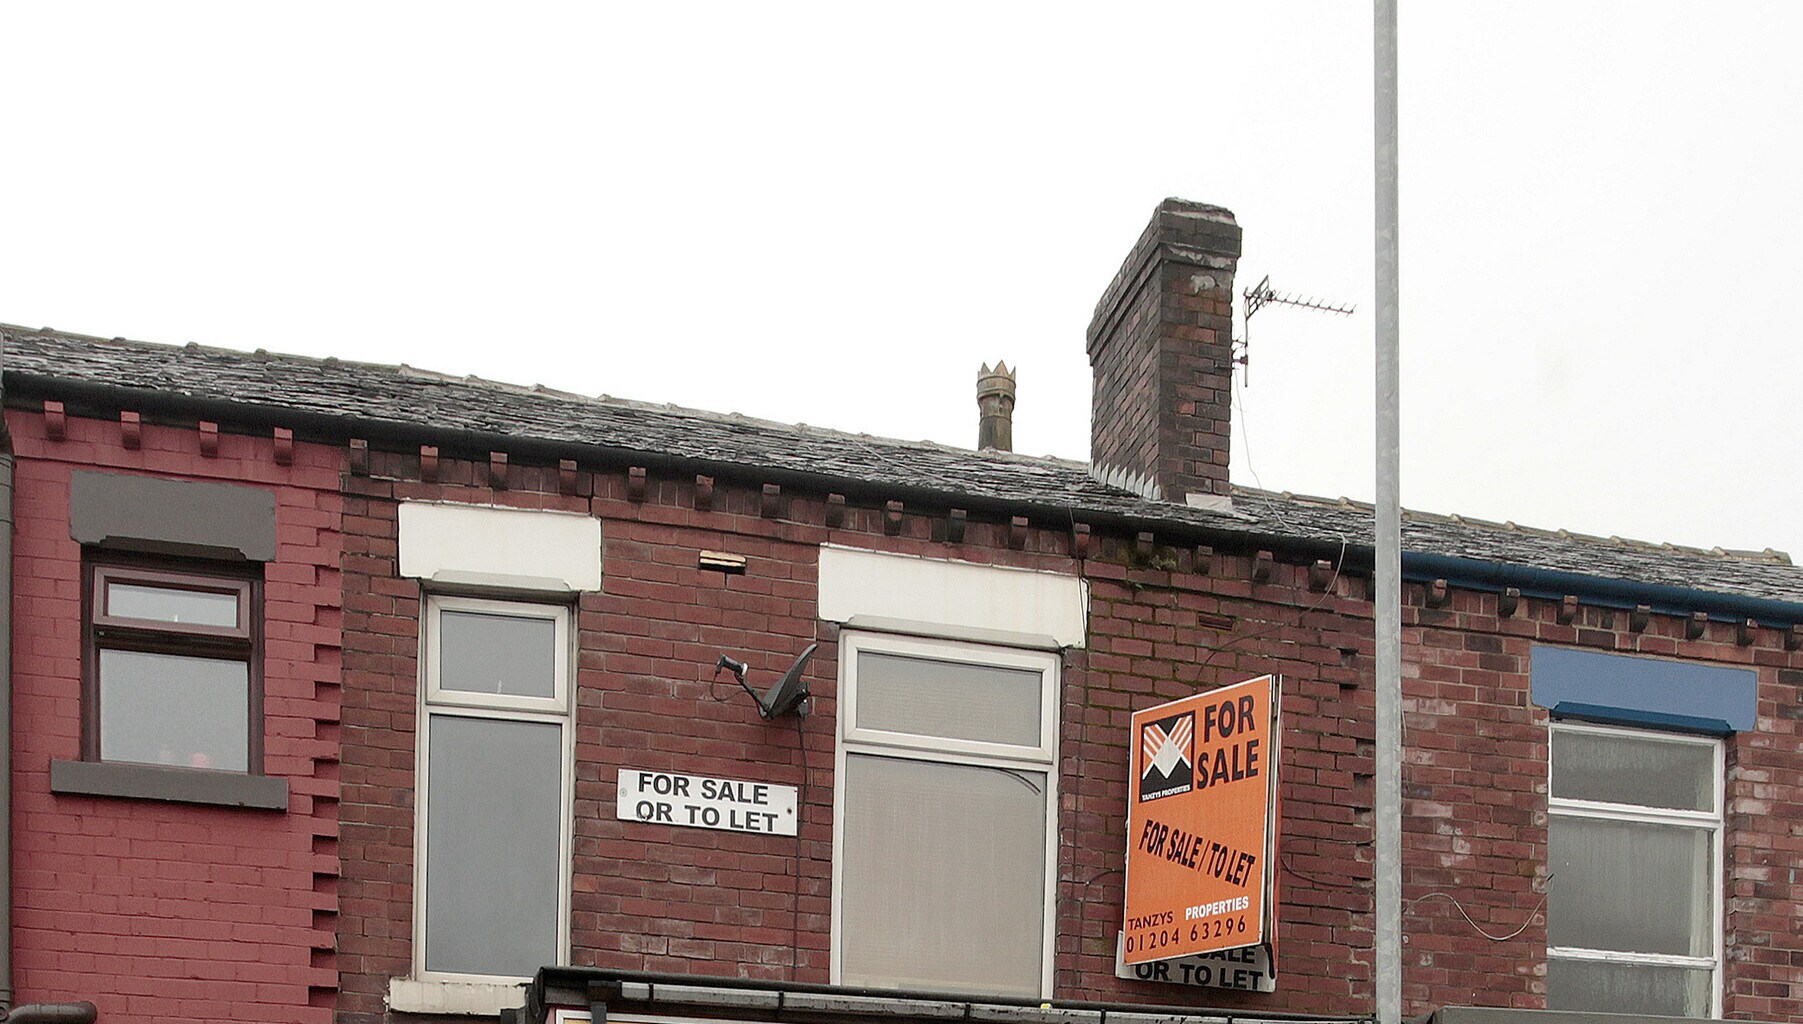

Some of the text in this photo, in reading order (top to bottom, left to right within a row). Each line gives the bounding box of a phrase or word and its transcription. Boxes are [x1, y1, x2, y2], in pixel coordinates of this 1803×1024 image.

[1204, 694, 1255, 744] FOR
[1196, 739, 1260, 790] SALE
[638, 772, 768, 805] FOR SALE
[635, 800, 778, 832] OR TO LET
[1139, 819, 1168, 858] FOR
[1166, 828, 1203, 869] SALE
[1206, 842, 1228, 879] TO
[1225, 849, 1256, 888] LET
[1128, 895, 1249, 931] TANZYS PROPERTIES
[1126, 915, 1246, 953] 01204 63296
[1135, 961, 1263, 990] OR TO LET
